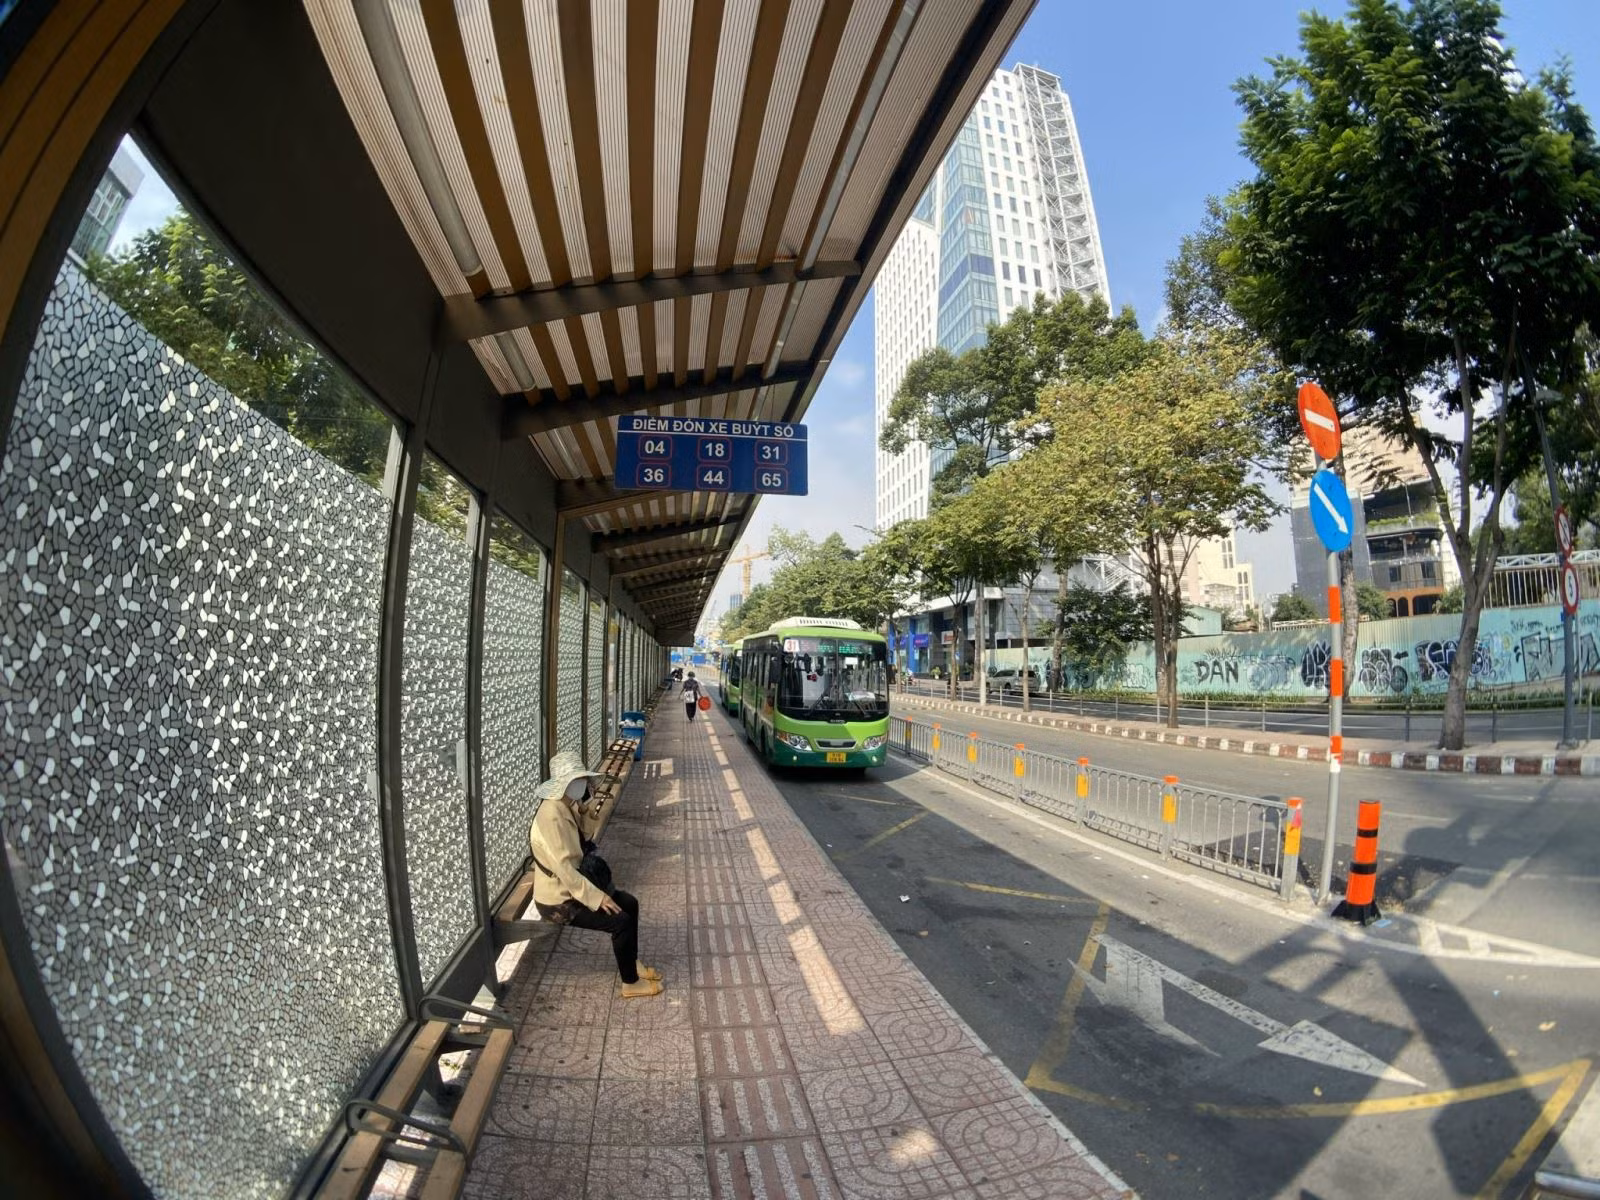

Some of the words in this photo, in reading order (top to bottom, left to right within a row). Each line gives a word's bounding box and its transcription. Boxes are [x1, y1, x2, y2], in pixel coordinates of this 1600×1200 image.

[672, 418, 705, 433] ĐÓN
[709, 421, 728, 434] XE
[732, 421, 770, 436] BUÝT
[644, 440, 665, 454] 04
[705, 443, 725, 457] 18
[762, 446, 780, 460] 31
[643, 468, 664, 482] 36
[703, 470, 724, 484] 44
[762, 473, 782, 487] 65
